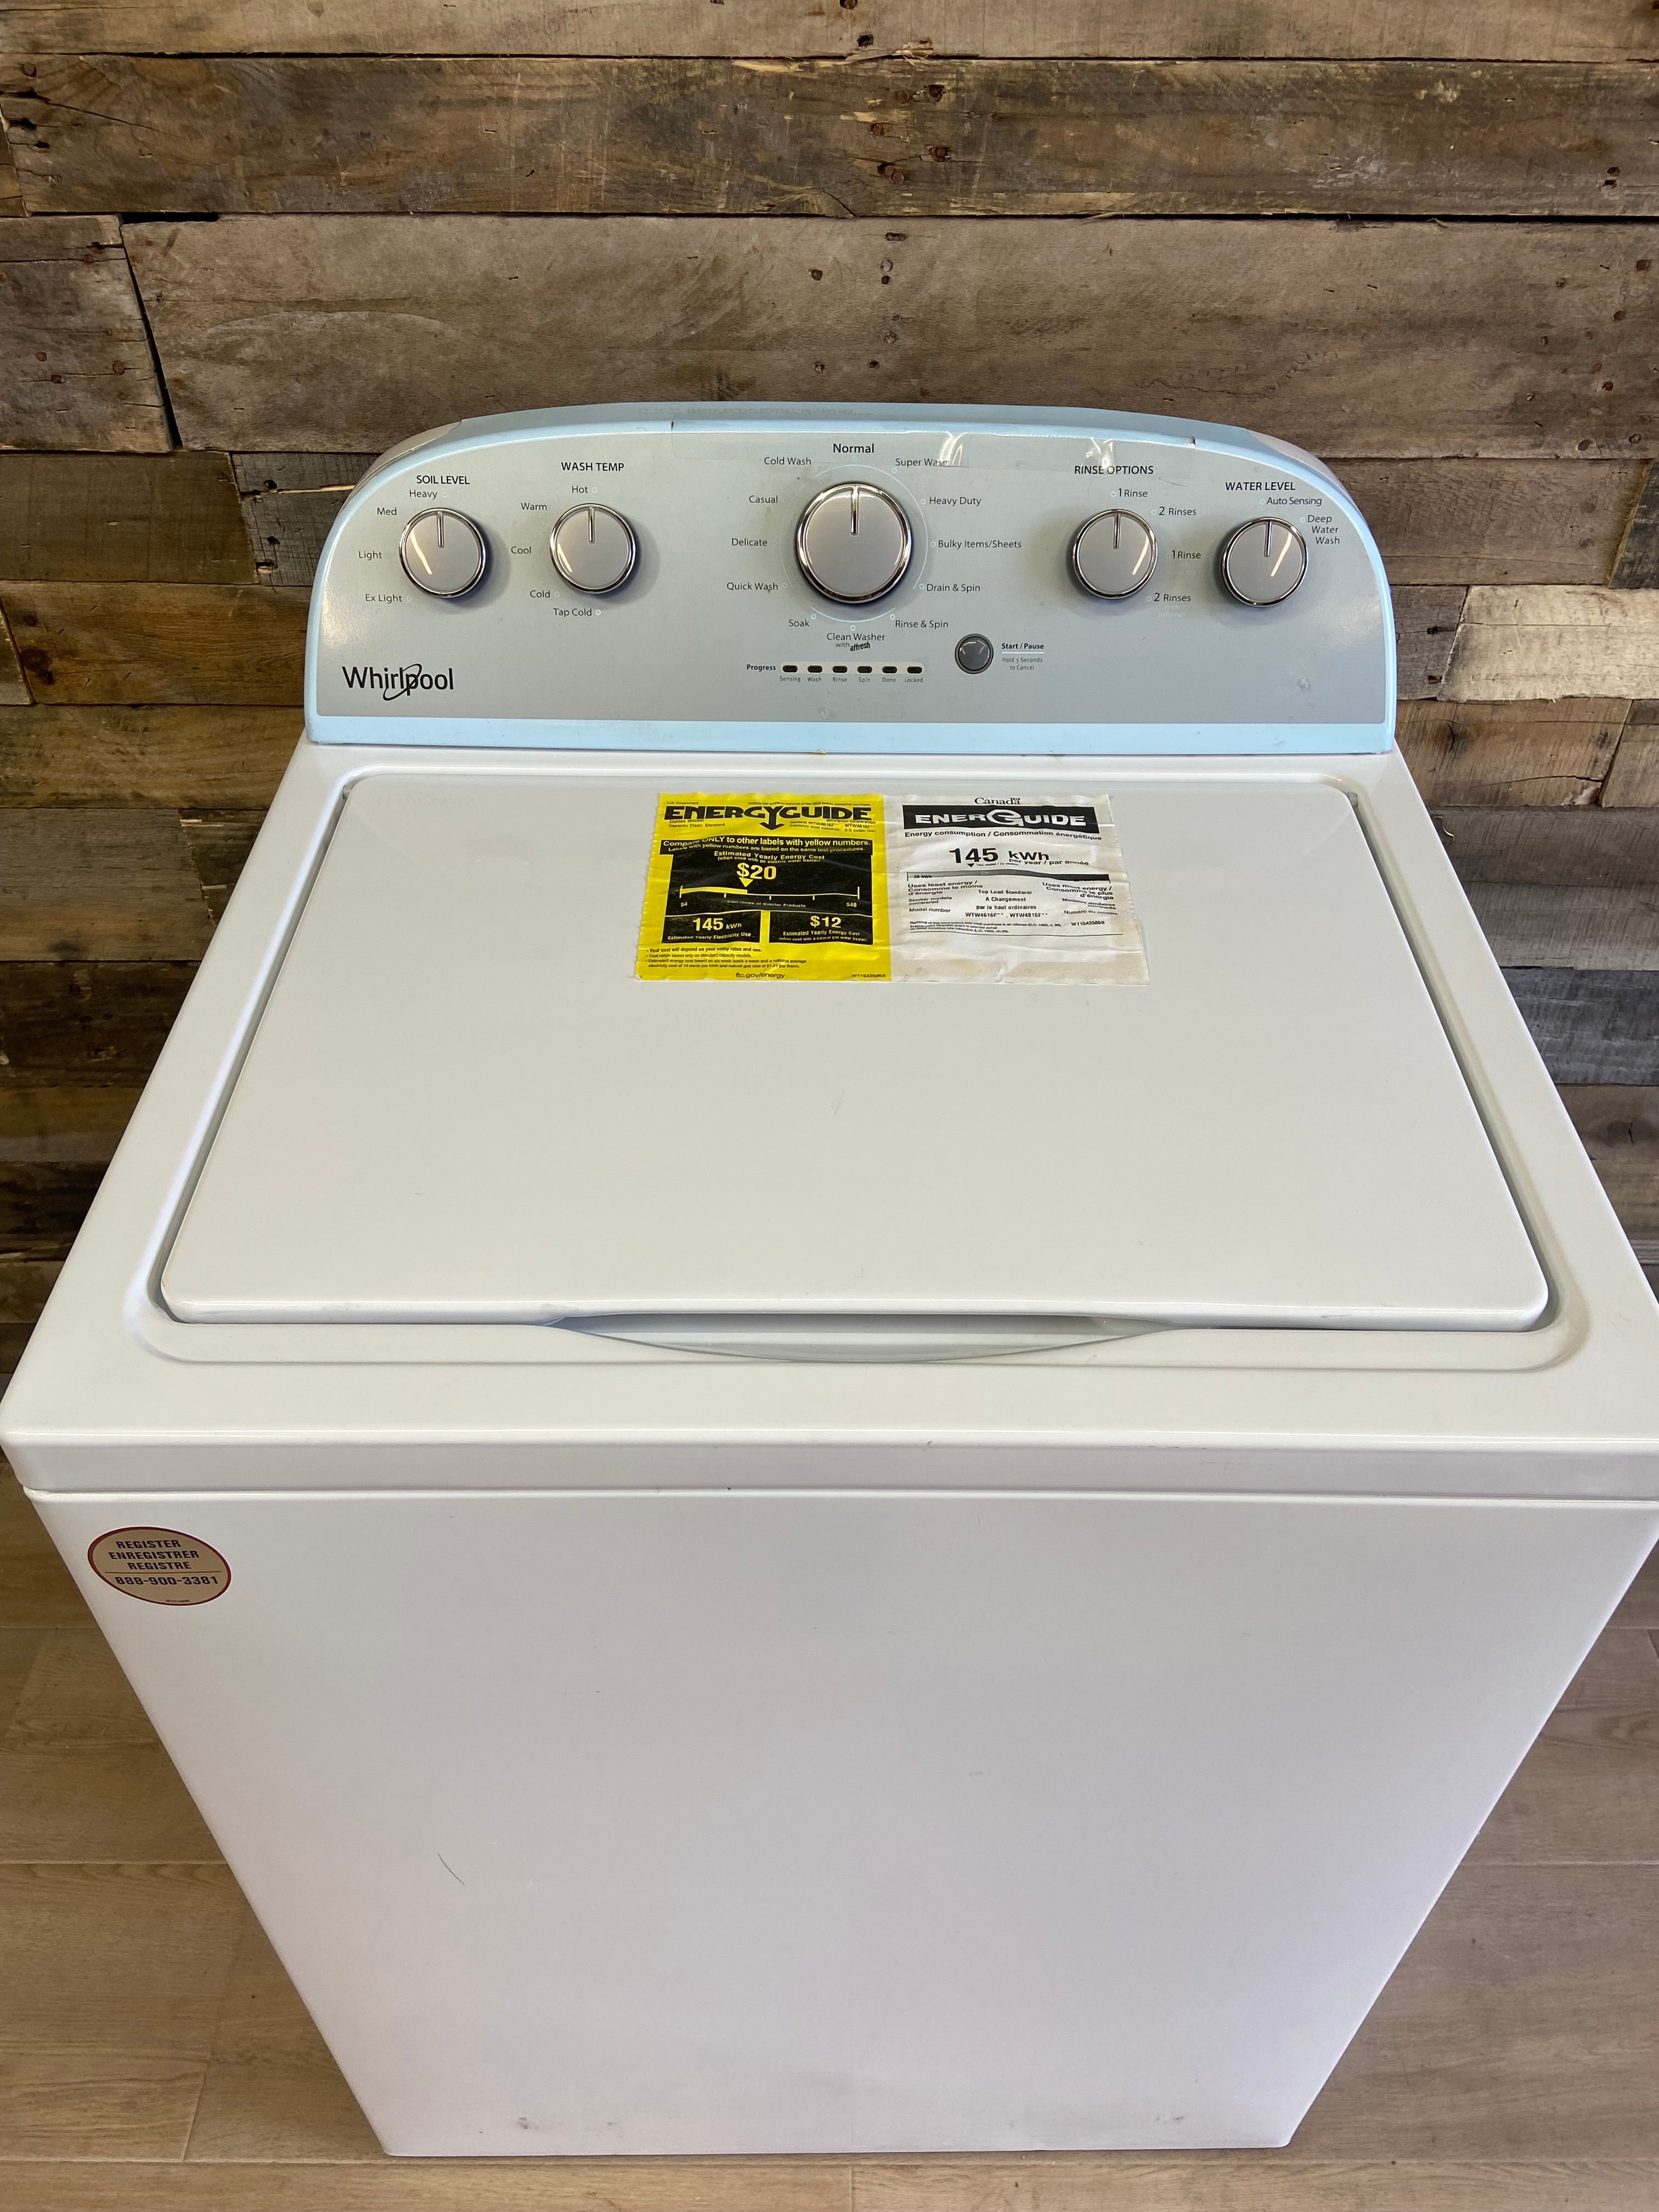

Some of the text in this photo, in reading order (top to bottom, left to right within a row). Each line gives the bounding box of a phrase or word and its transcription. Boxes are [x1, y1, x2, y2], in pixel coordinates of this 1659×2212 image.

[833, 443, 874, 454] Normal
[561, 461, 624, 472] WASH TEMP
[764, 457, 812, 466] Cold Wash
[895, 458, 922, 469] Super
[1074, 465, 1154, 475] RINSE OPTIONS
[416, 475, 470, 485] SOIL LEVEL
[571, 485, 588, 494] Hot
[1225, 482, 1296, 492] WATER LEVEL
[409, 489, 438, 500] Heavy
[1118, 488, 1148, 498] 1 Rinse
[748, 495, 778, 504] Casual
[929, 496, 981, 507] Heavy Duty
[1266, 497, 1322, 507] Auto Sensing
[377, 507, 397, 516] Med
[520, 502, 548, 511] Warm
[1158, 506, 1197, 516] 2 Rinses
[1307, 515, 1332, 525] Deep
[1311, 526, 1339, 534] Water
[731, 538, 768, 546] Delicate
[938, 539, 1022, 550] Bulky Items/Sheets
[1315, 536, 1340, 545] Wash
[511, 545, 532, 555] Cool
[1171, 550, 1201, 560] 1 Rinse
[358, 550, 382, 561] Light
[726, 582, 778, 591] Quick Wash
[926, 583, 980, 595] Drain & Spin
[365, 593, 403, 605] Ex Light
[529, 590, 550, 599] Cold
[1153, 592, 1192, 602] 2 Rinses
[553, 608, 592, 619] Tap Cold
[788, 619, 810, 628] Soak
[895, 619, 949, 631] Rinse & Spin
[827, 633, 885, 641] Clean Washer
[850, 641, 871, 651] affresh
[746, 664, 776, 672] Progress
[342, 663, 454, 701] Whirlpool
[664, 805, 872, 826] ENERGYGUIDE
[915, 809, 1086, 827] ENERGUIDE
[1056, 832, 1102, 840] énergétique
[804, 839, 831, 847] yellow
[754, 853, 778, 861] Yearly
[949, 848, 1050, 864] 145 kWh
[736, 862, 777, 880] $20
[693, 917, 724, 932] 145
[810, 915, 842, 929] $12
[115, 1539, 181, 1549] REGISTER
[108, 1550, 200, 1560] ENREGISTRER
[127, 1561, 192, 1570] REGISTRE
[115, 1576, 219, 1585] 888-900-3381
